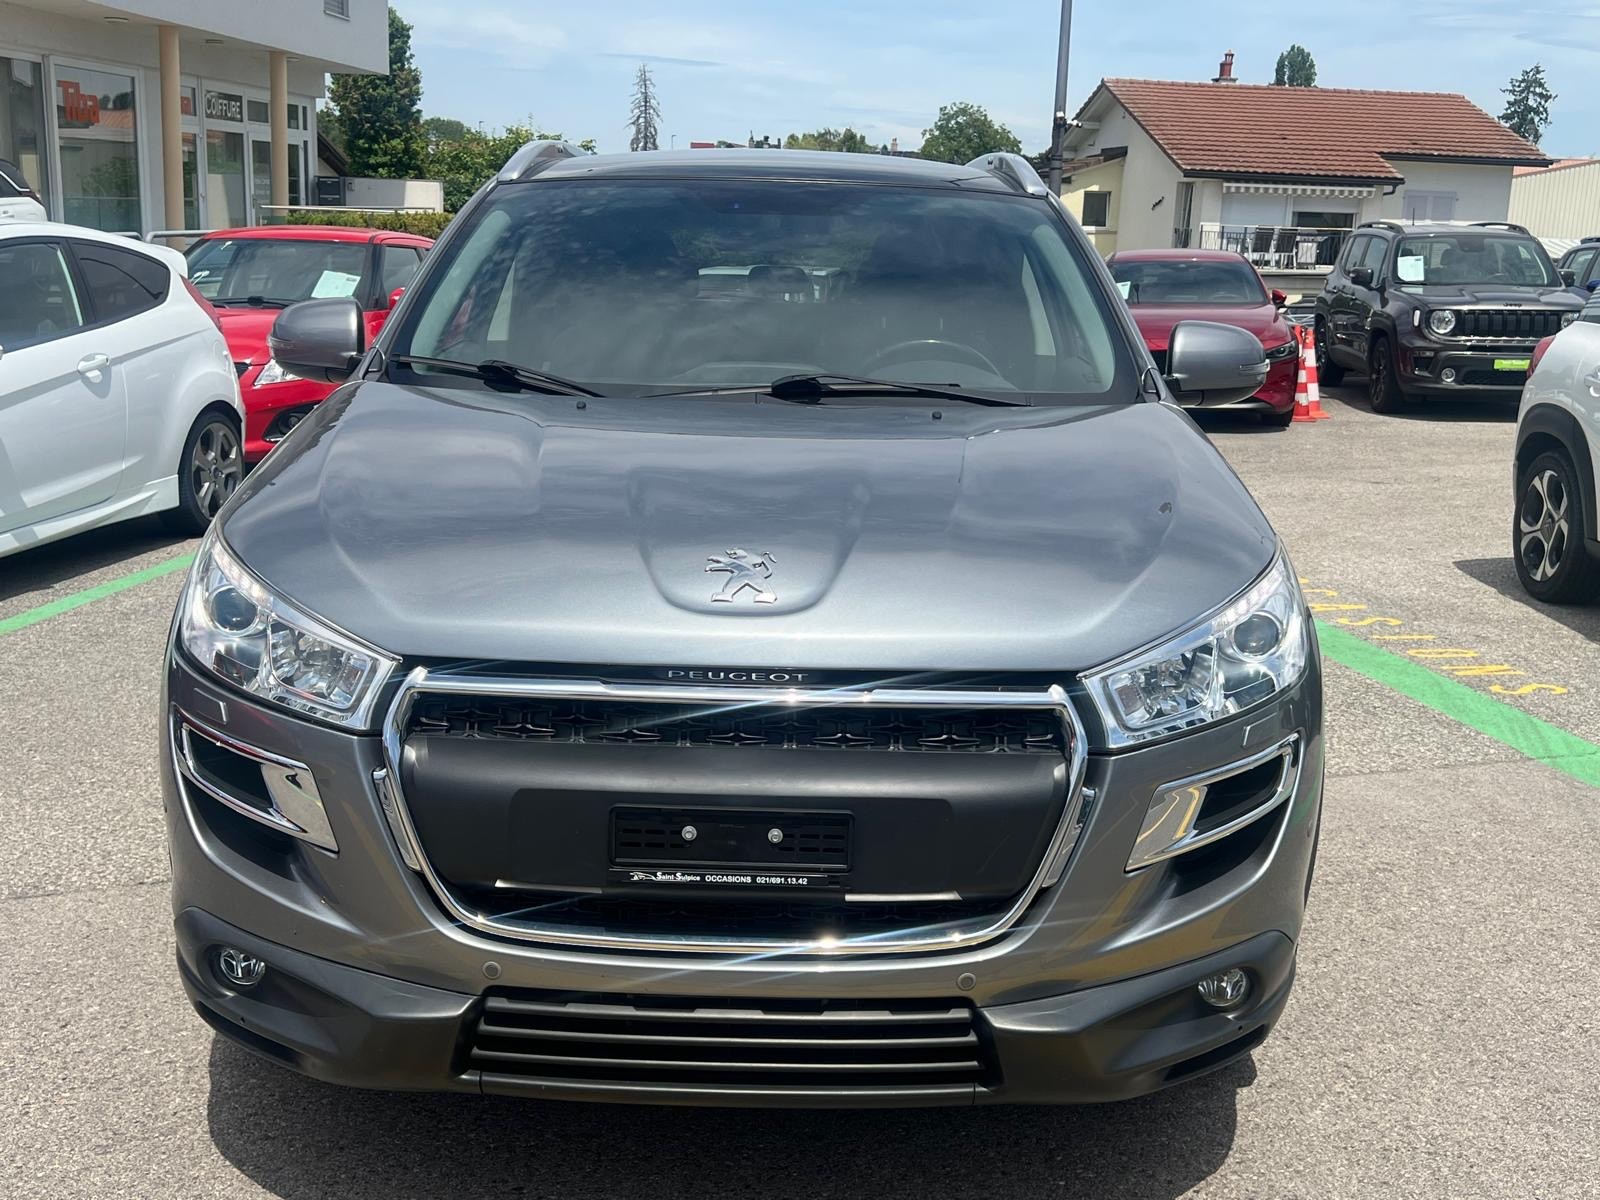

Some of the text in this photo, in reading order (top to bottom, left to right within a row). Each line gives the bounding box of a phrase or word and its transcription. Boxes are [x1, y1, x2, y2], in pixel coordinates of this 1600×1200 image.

[205, 94, 241, 119] COIFFURE
[667, 670, 809, 682] PEUGEOT
[705, 875, 752, 883] OCCASIONS
[756, 877, 808, 885] 021/691.13.42
